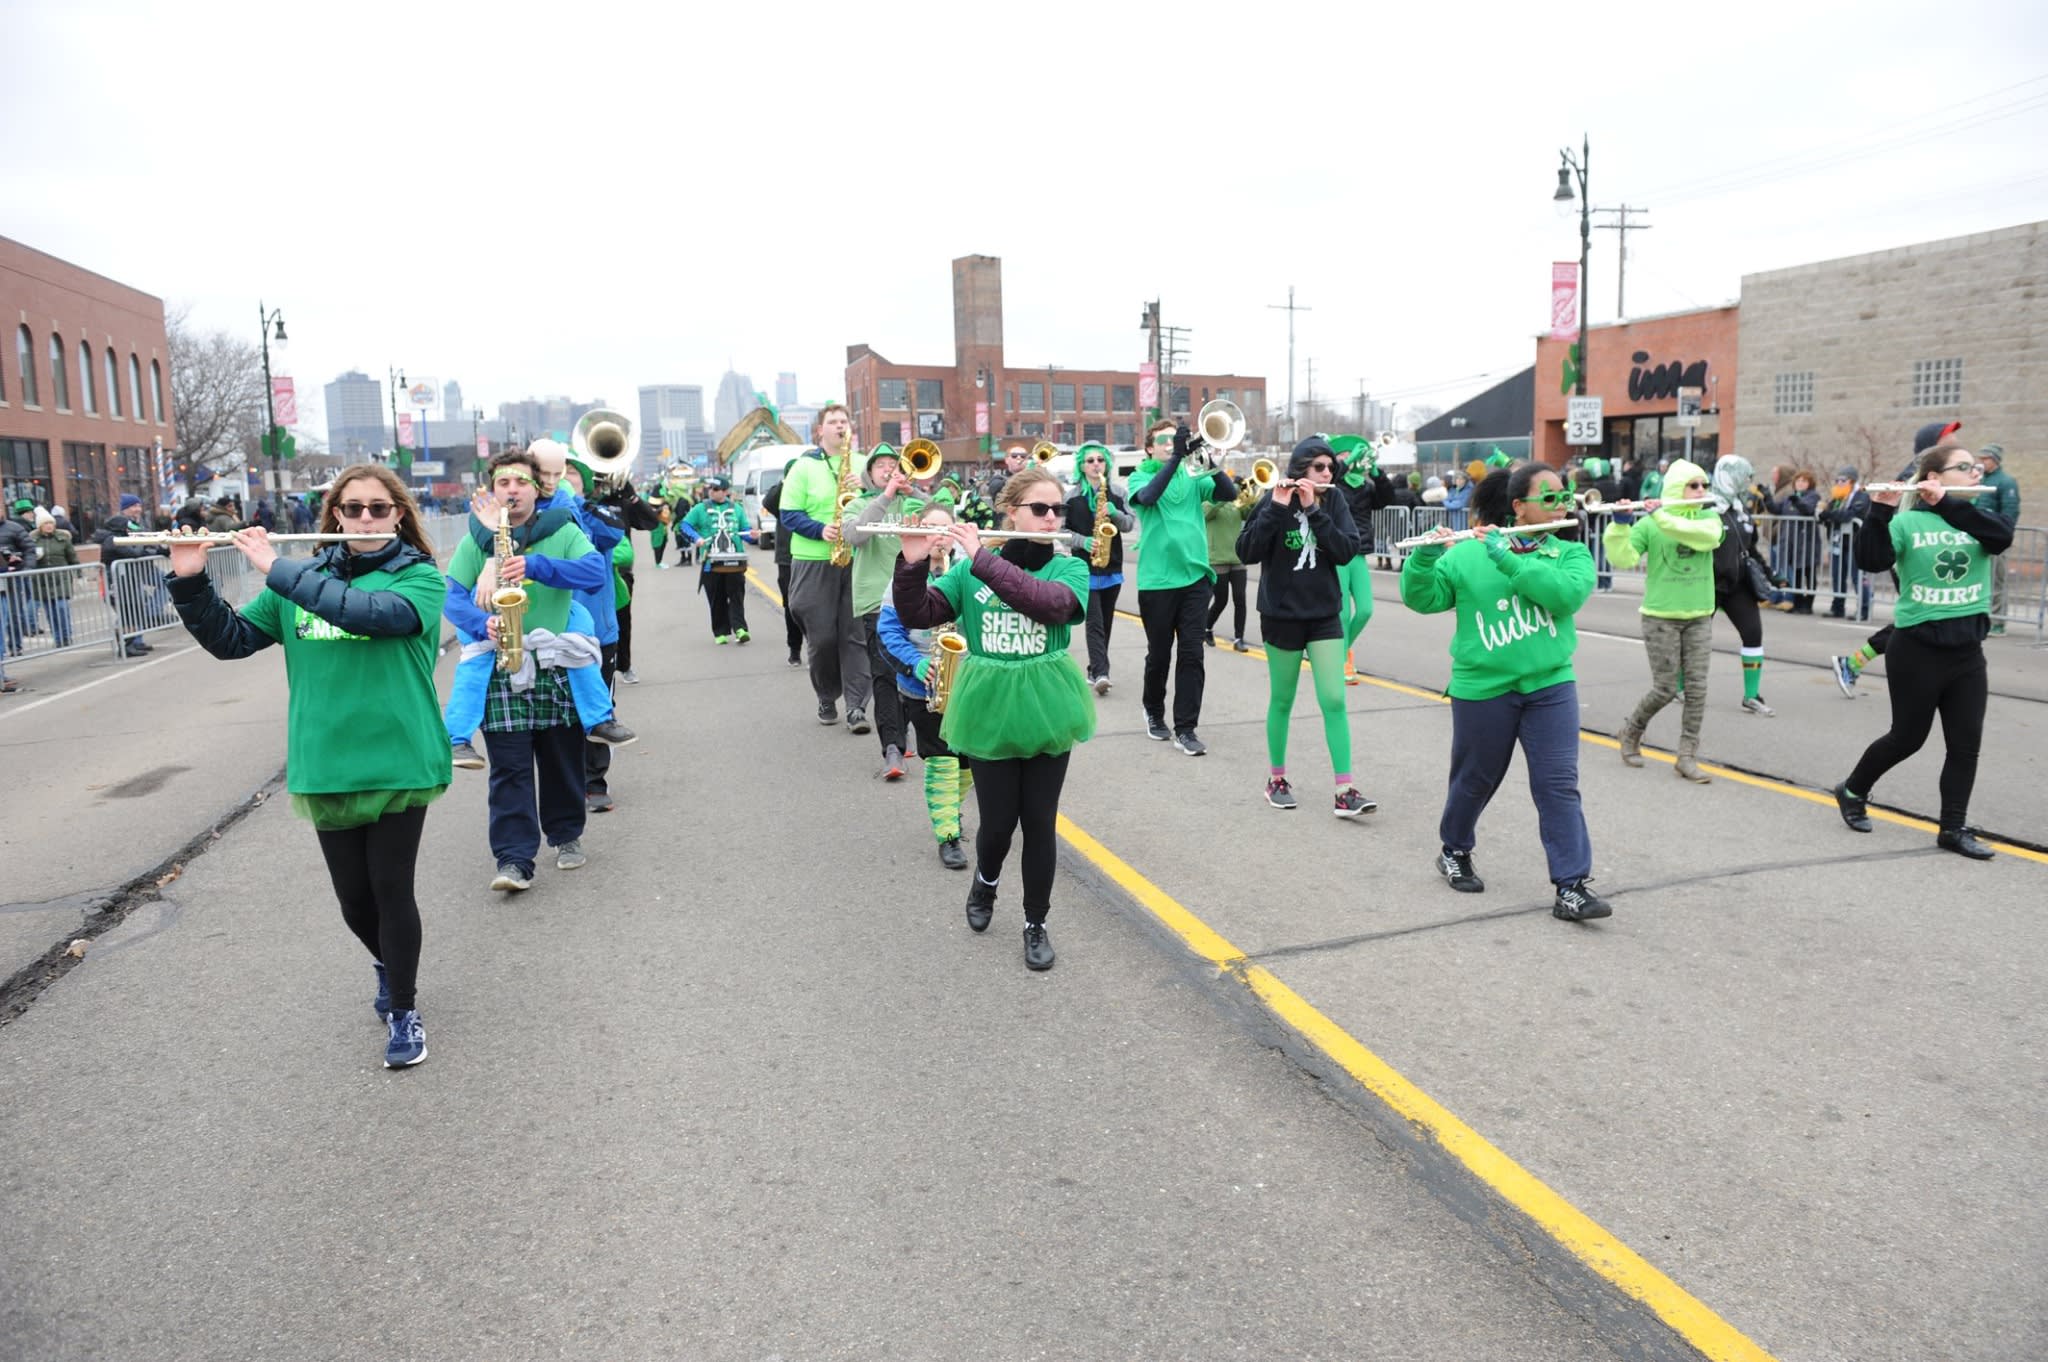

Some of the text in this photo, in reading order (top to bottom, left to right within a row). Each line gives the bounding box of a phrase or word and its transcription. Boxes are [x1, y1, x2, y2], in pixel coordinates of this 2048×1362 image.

[1628, 351, 1707, 402] ima
[1571, 402, 1600, 410] SPEED
[1573, 411, 1597, 419] LIMIT
[1572, 421, 1598, 438] 35
[1911, 530, 1980, 549] LUCK
[1911, 583, 1983, 605] SHIRT
[1475, 594, 1557, 651] lucky
[981, 633, 1047, 655] NIGANS
